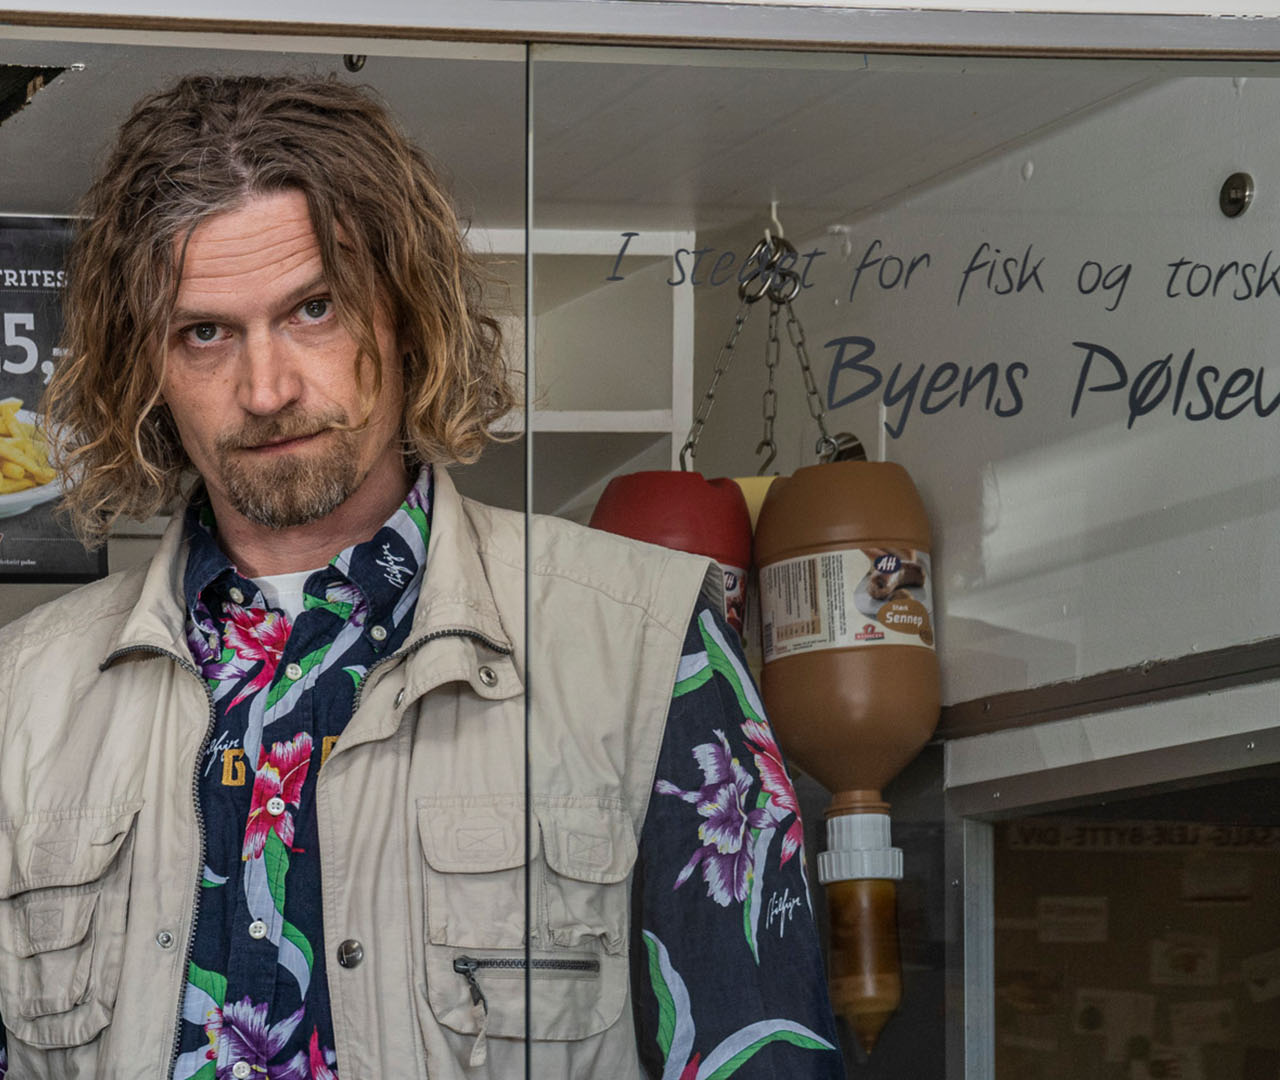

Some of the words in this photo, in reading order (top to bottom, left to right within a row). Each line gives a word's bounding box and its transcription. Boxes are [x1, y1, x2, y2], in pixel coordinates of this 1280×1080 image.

[606, 232, 640, 281] I
[848, 239, 931, 302] for
[957, 242, 1047, 306] fisk
[1077, 260, 1133, 312] og
[824, 335, 1029, 440] Byens
[877, 556, 897, 571] AH
[885, 611, 923, 627] Sennep
